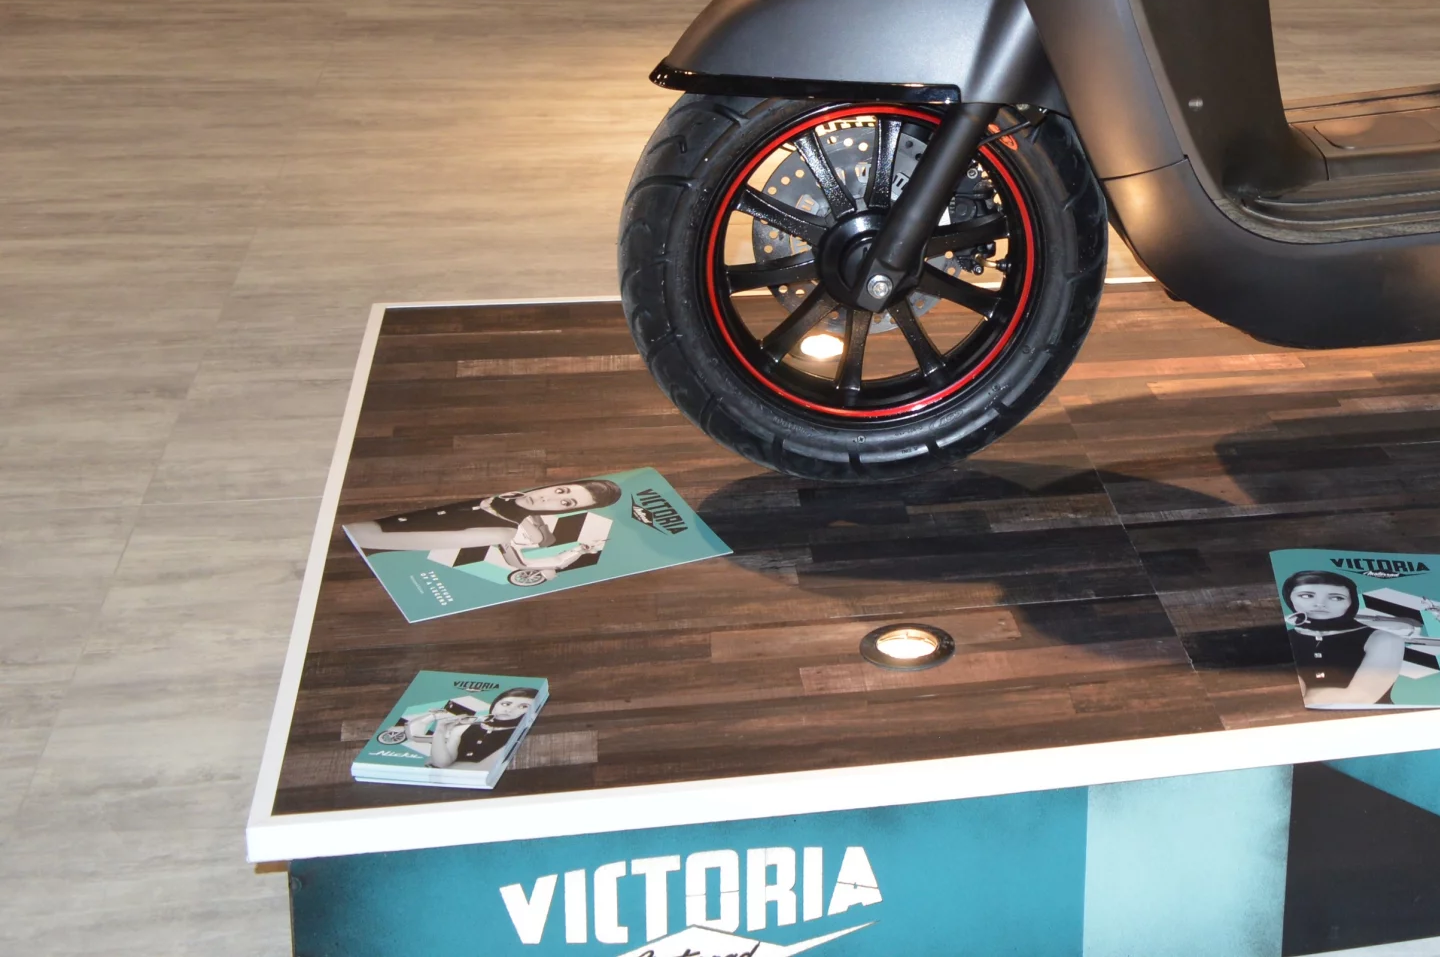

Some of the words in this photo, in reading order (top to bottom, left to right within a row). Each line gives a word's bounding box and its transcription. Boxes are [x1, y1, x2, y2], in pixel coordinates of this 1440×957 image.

[636, 488, 689, 535] VICTORIA
[1330, 558, 1430, 572] VICTORIA
[453, 680, 500, 690] VICTORIA
[499, 846, 883, 945] VICTORIA
